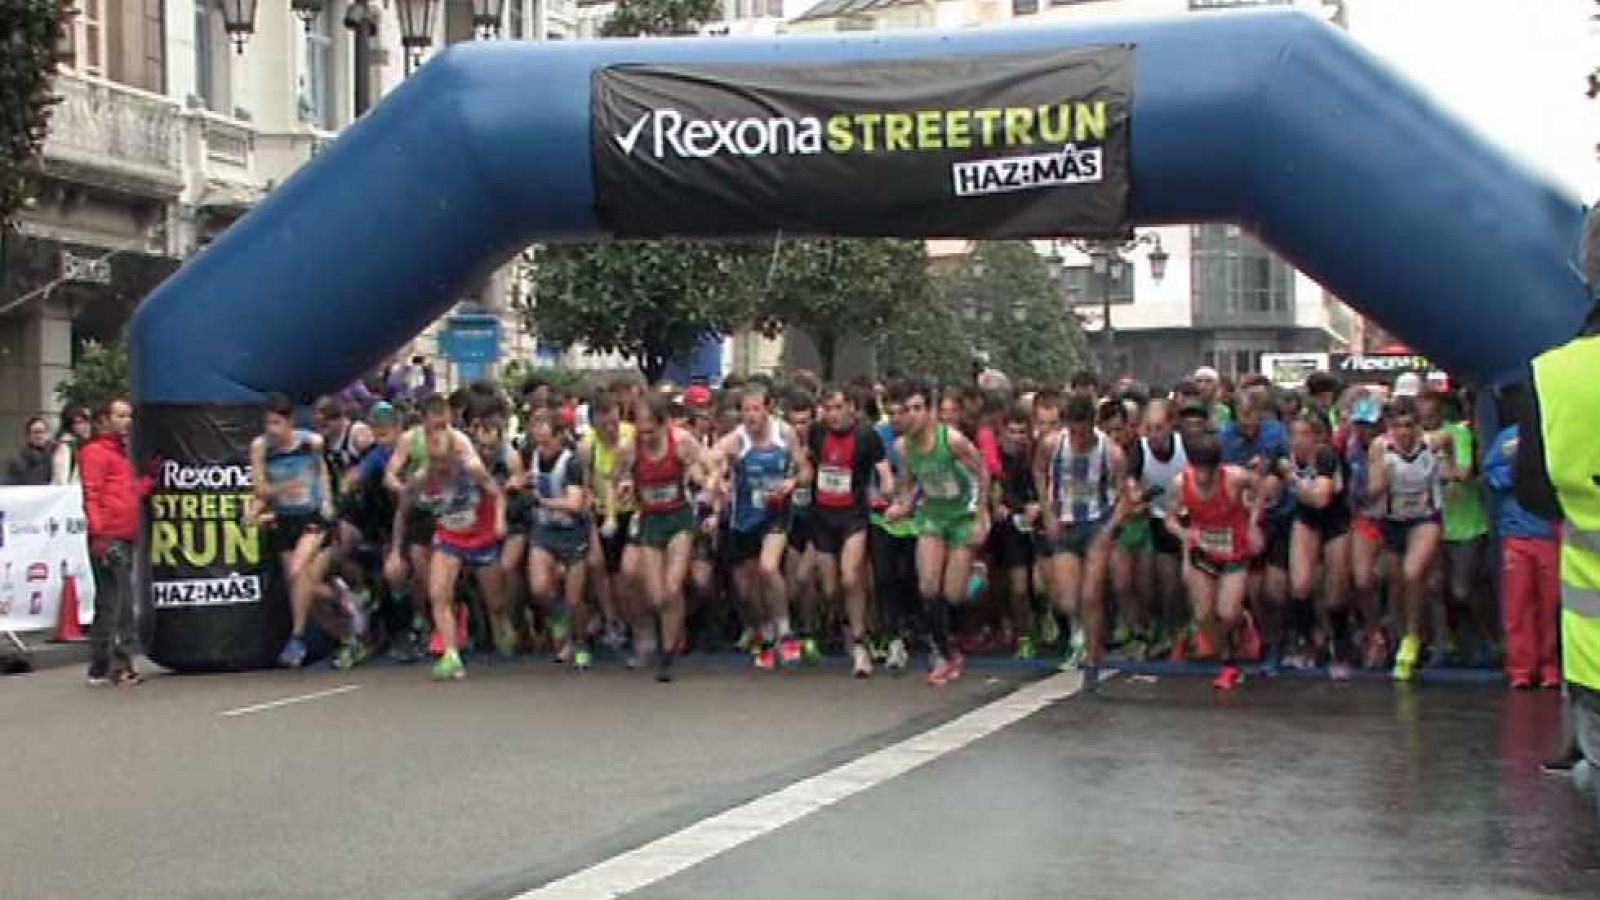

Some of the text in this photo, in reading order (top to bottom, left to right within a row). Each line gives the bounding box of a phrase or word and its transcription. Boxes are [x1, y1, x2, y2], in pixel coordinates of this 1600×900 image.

[653, 101, 1109, 158] Rexona STREETRUN
[164, 459, 254, 489] Rexona
[151, 494, 257, 519] STREET
[151, 521, 259, 566] RUN
